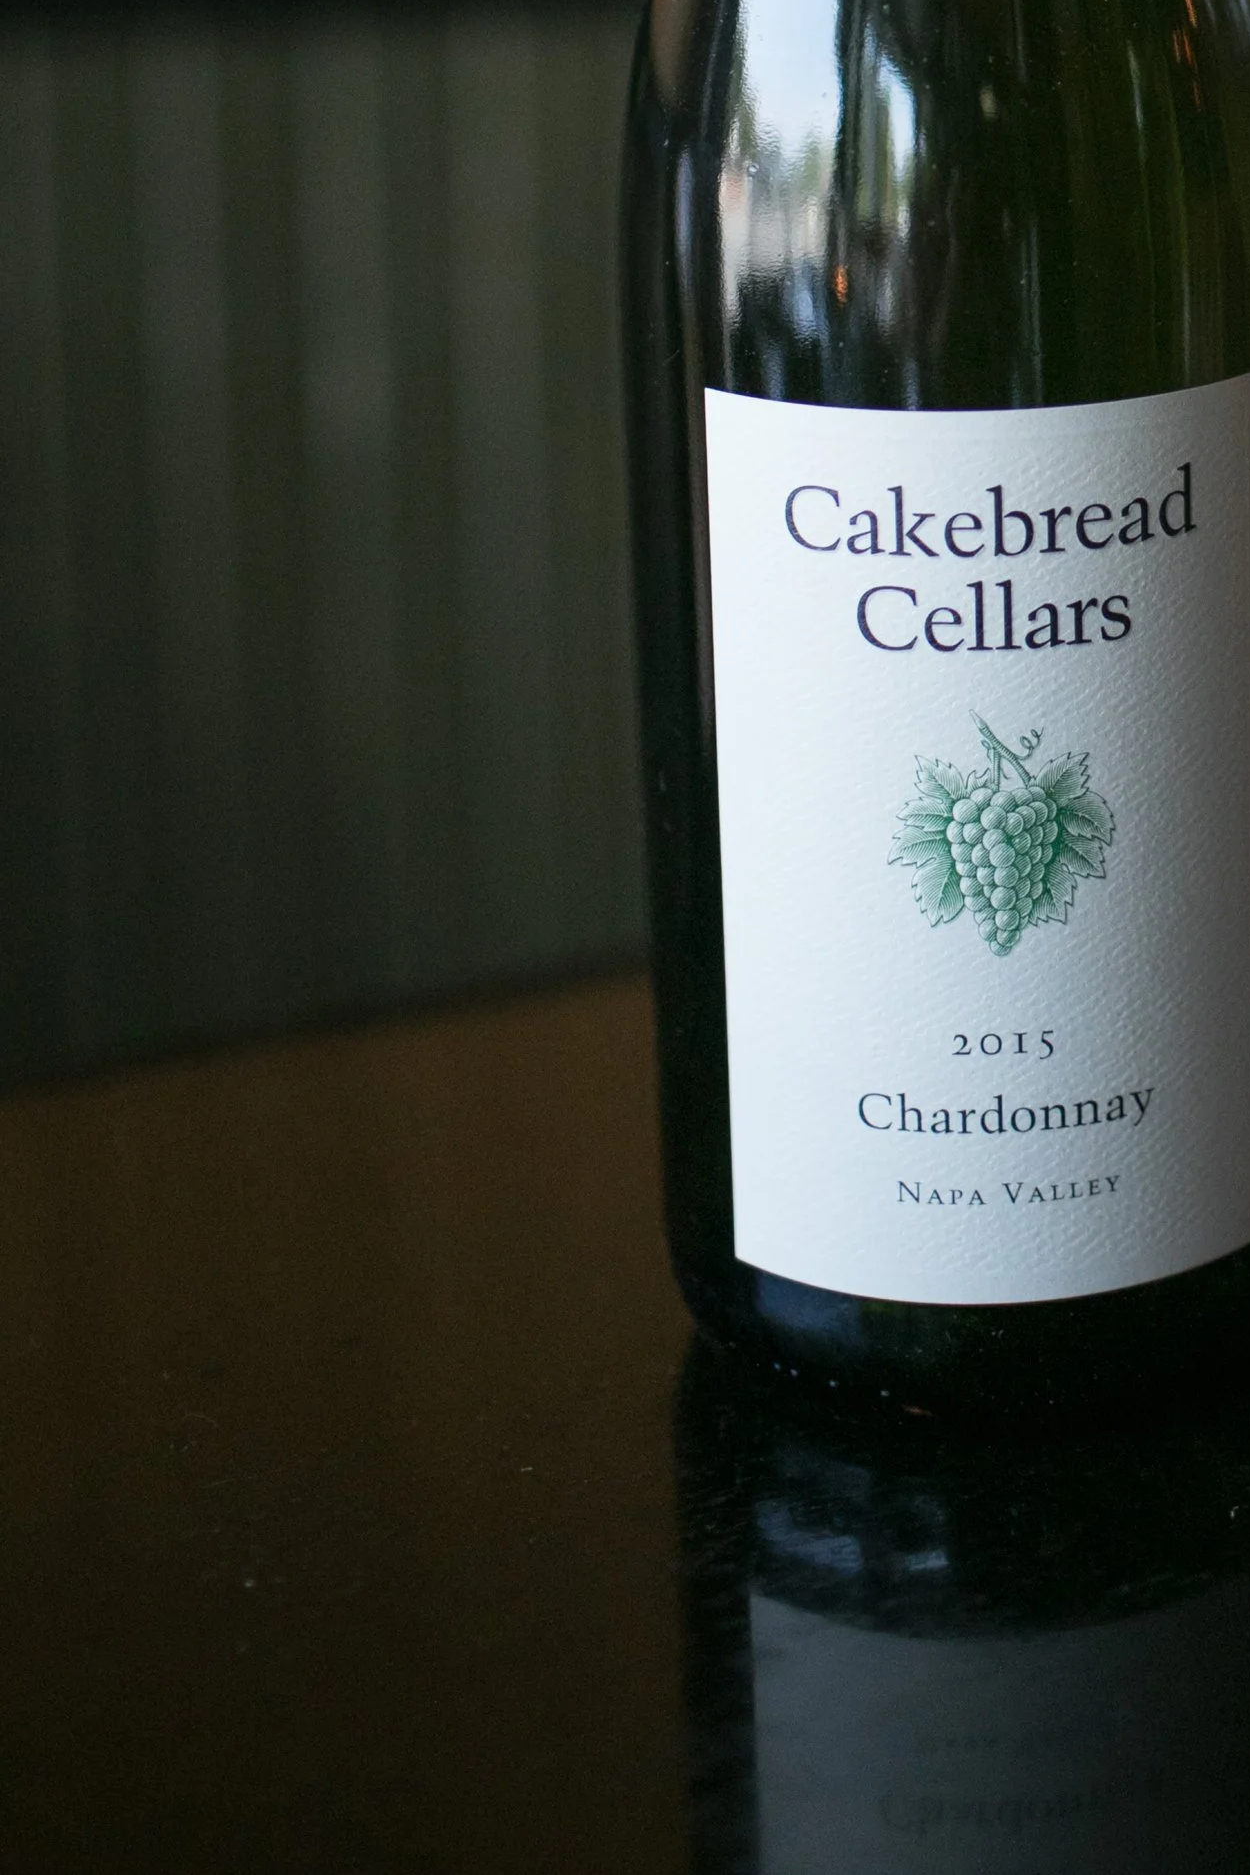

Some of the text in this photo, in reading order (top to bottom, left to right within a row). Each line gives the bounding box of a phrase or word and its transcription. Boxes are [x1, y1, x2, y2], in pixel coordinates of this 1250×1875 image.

[784, 461, 1197, 559] Cakebread
[856, 578, 1133, 654] Cellars
[951, 1029, 1056, 1061] 2015
[858, 1087, 1156, 1135] Chardonnay
